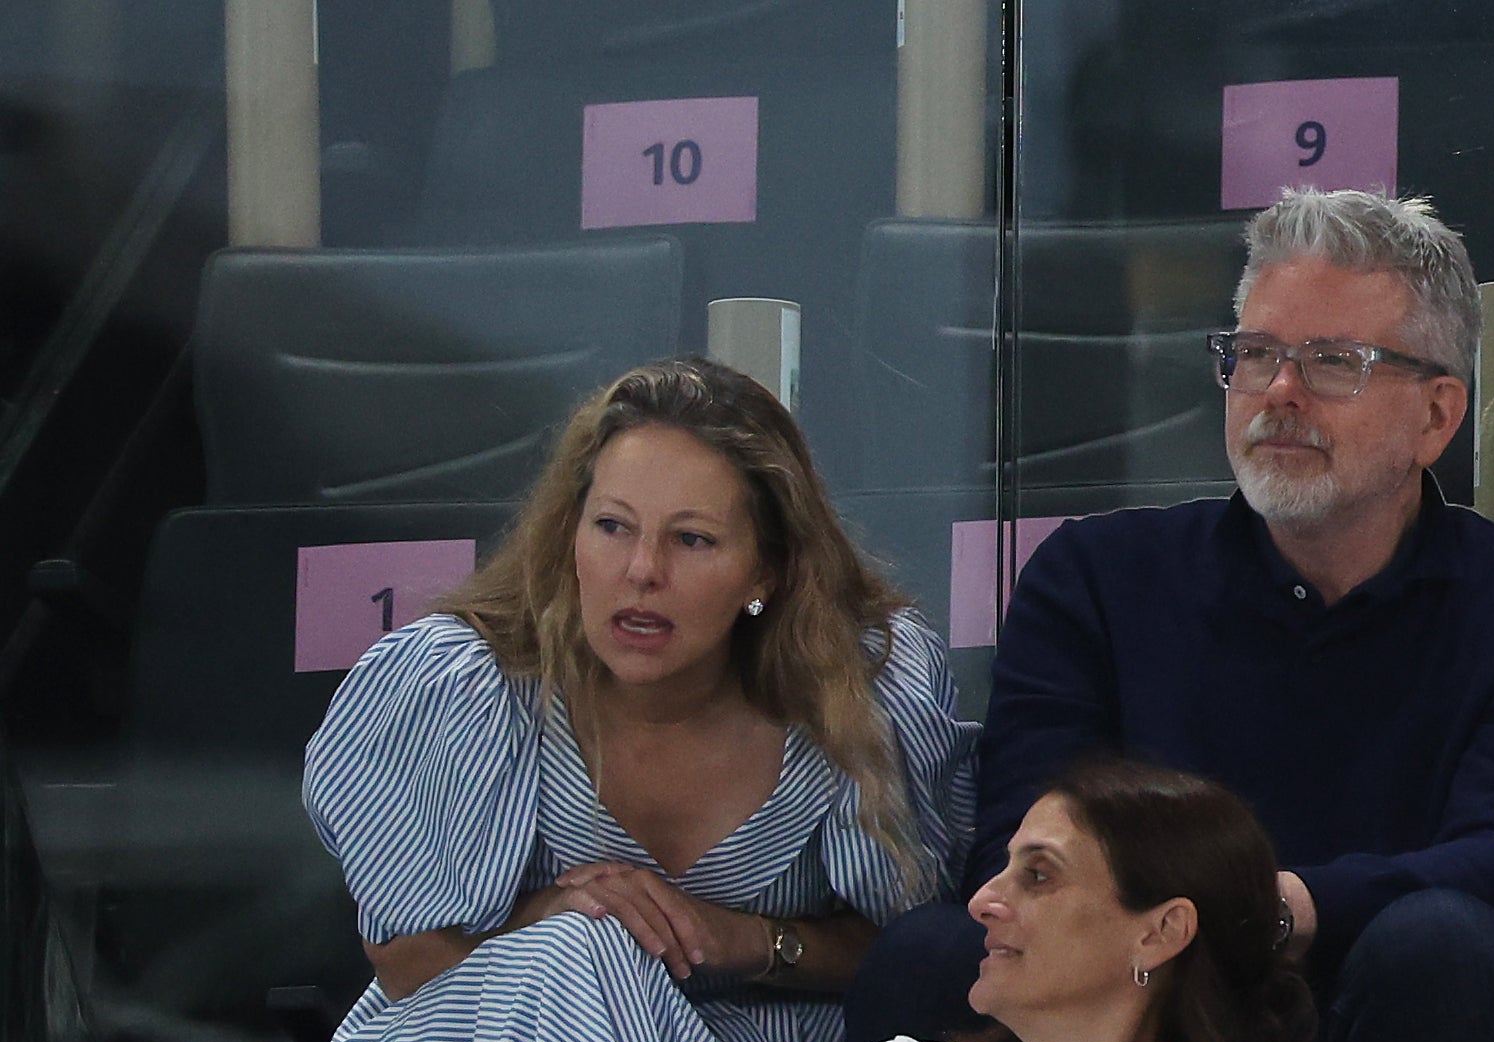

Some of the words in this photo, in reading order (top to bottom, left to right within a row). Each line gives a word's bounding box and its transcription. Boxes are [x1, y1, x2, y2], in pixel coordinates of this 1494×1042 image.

[642, 139, 703, 187] 10
[1295, 121, 1327, 167] 9
[371, 587, 394, 632] 1
